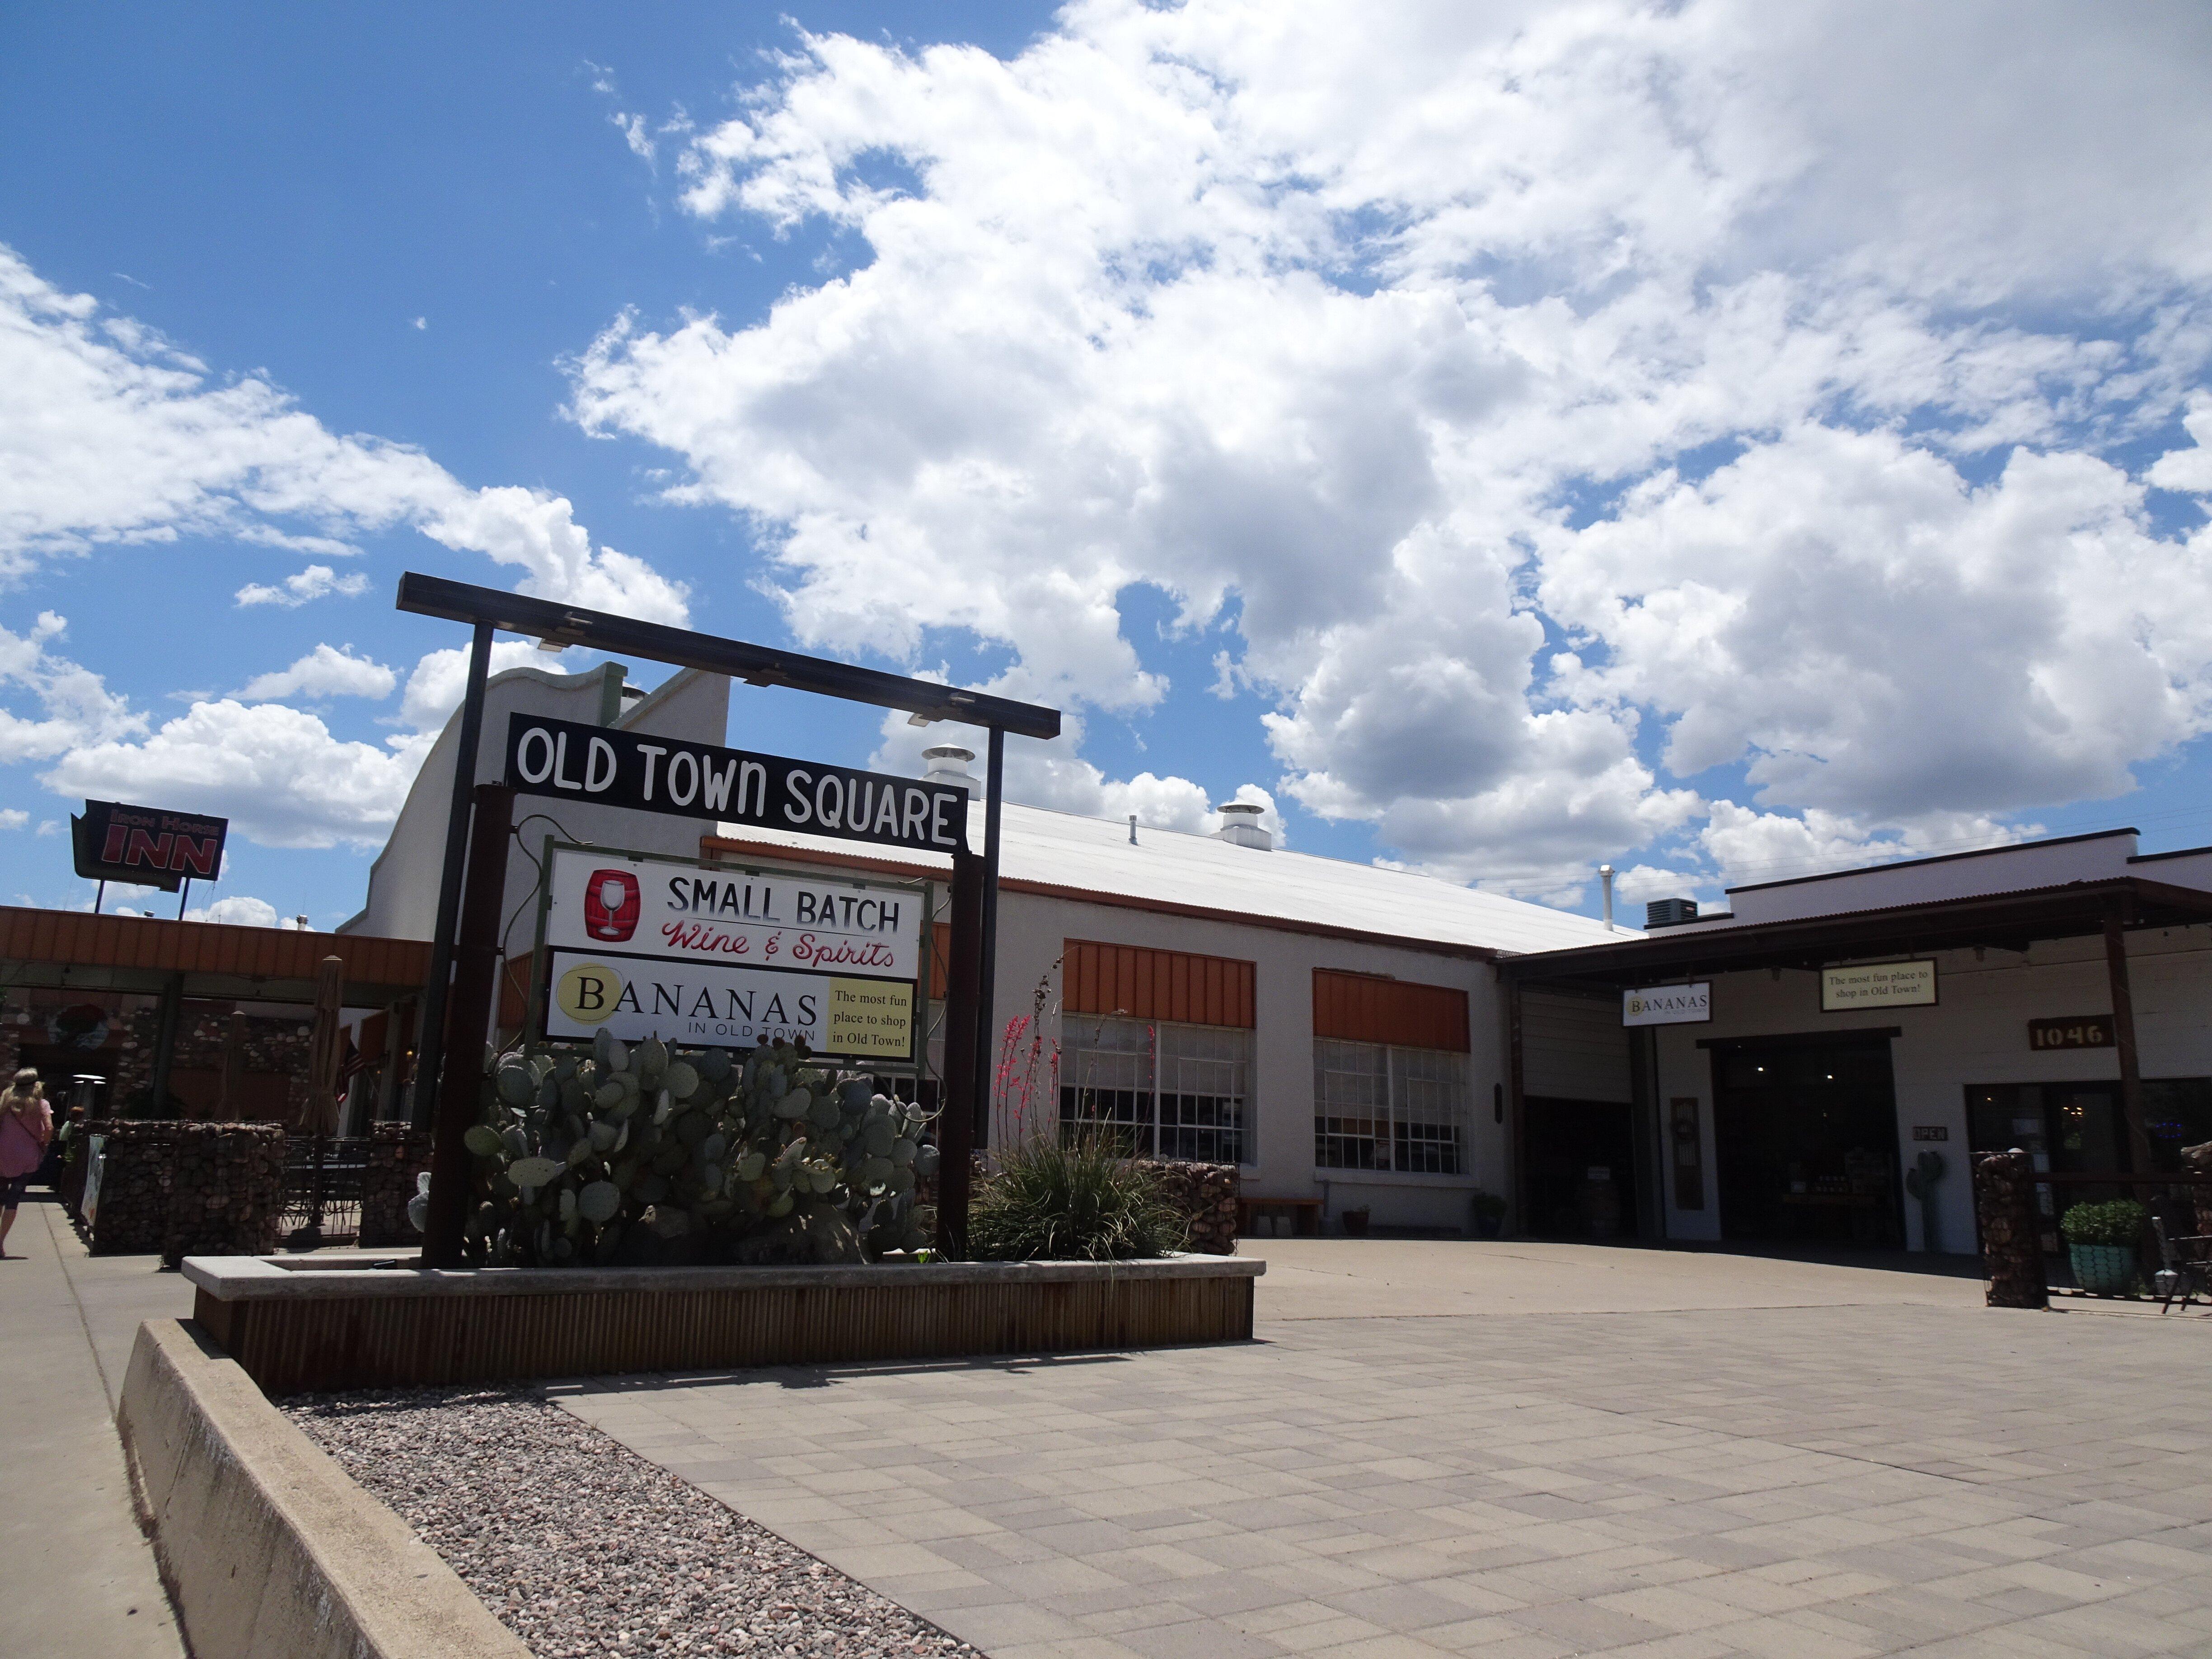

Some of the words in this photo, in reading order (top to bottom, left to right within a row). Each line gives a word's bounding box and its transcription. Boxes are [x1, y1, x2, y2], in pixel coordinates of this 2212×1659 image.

[516, 727, 617, 793] OLD
[636, 744, 767, 817] TOWN
[784, 769, 958, 846] SQUARE
[110, 809, 155, 827] IRON
[161, 815, 220, 836] HORSE
[102, 824, 218, 874] INN
[666, 876, 781, 923] SMALL
[796, 890, 900, 934] BATCH
[661, 919, 750, 954] Wine
[764, 930, 782, 961] &
[792, 933, 895, 967] Spirits
[1828, 976, 1846, 985] The
[1848, 975, 1870, 984] most
[1873, 973, 1888, 982] fun
[1890, 971, 1916, 983] place
[574, 975, 817, 1026] BANANAS
[834, 990, 856, 1002] The
[859, 994, 886, 1005] most
[889, 994, 907, 1007] fun
[1835, 989, 1856, 999] shop
[1859, 988, 1869, 997] in
[1870, 986, 1888, 996] Old
[1892, 984, 1921, 994] Town!
[1631, 994, 1707, 1012] BANANAS
[833, 1011, 863, 1024] place
[867, 1014, 877, 1024] to
[881, 1014, 906, 1029] shop
[688, 1021, 706, 1034] IN
[715, 1023, 753, 1037] OLD
[762, 1026, 815, 1041] TOWN
[832, 1031, 843, 1043] in
[847, 1032, 867, 1045] Old
[871, 1034, 905, 1047] Town!
[2036, 1025, 2103, 1046] 1046
